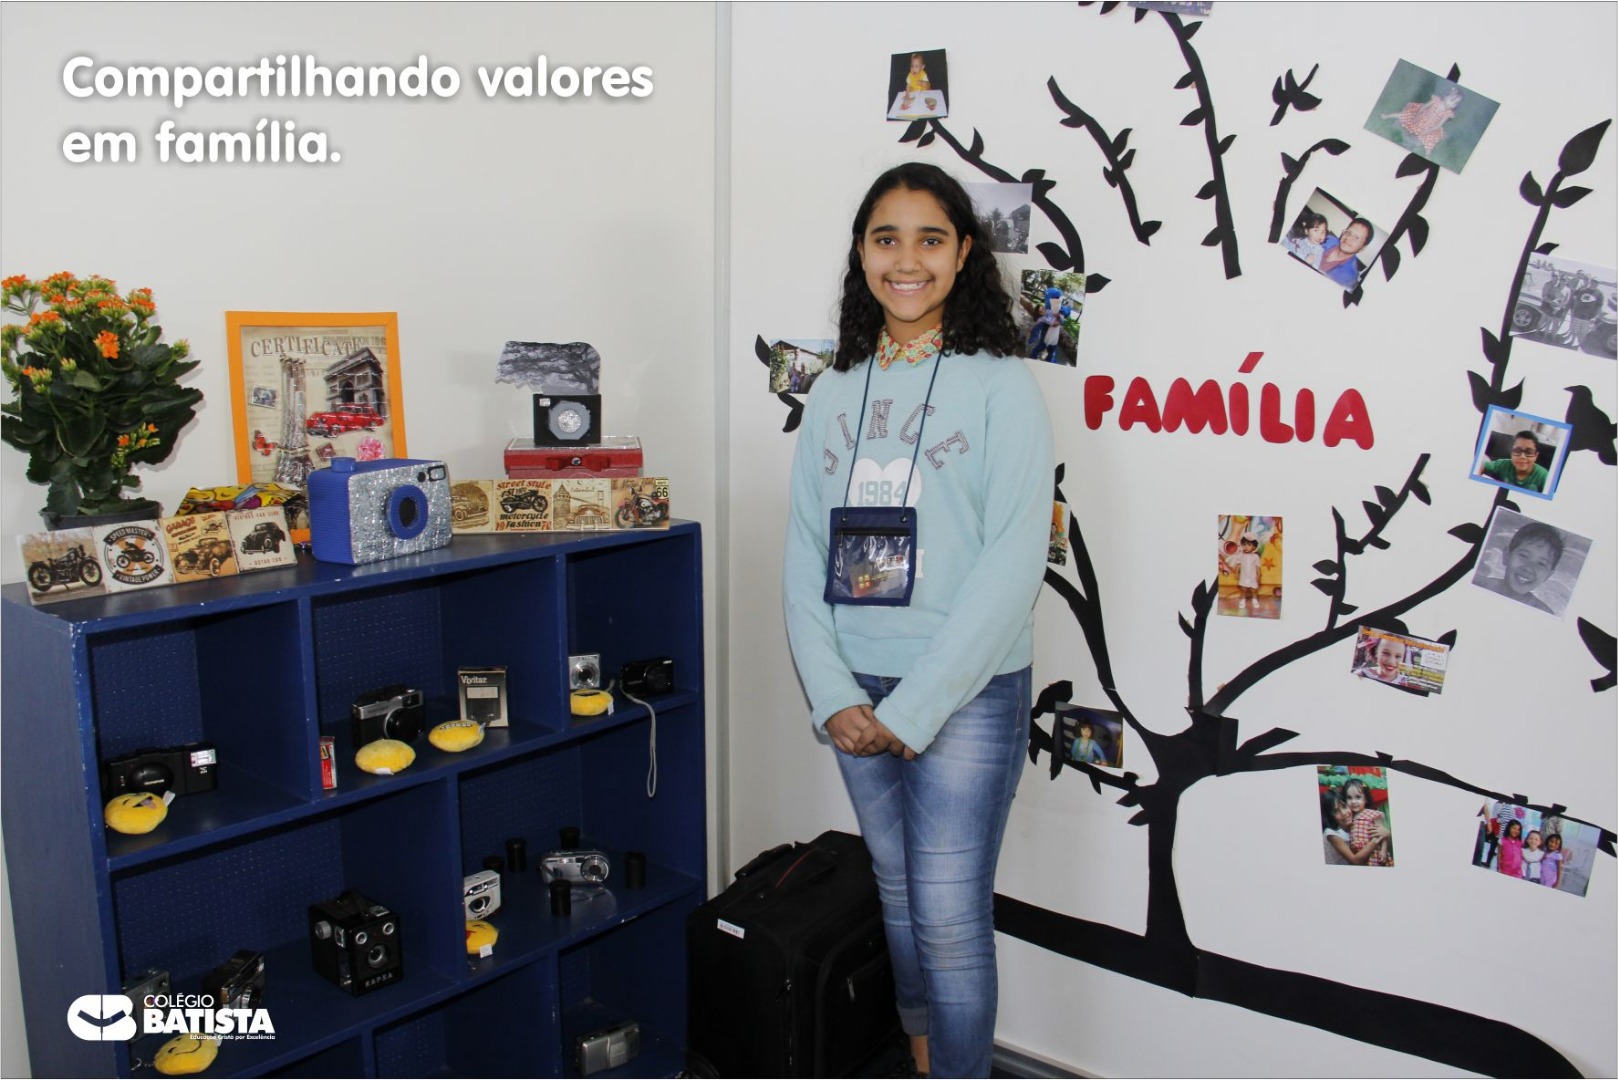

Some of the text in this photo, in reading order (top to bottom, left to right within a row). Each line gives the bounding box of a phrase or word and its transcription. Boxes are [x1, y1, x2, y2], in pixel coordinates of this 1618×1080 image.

[1084, 352, 1375, 450] FAMÍLIA
[656, 487, 669, 498] 66
[857, 480, 908, 506] 1984
[460, 675, 488, 684] Vivitar
